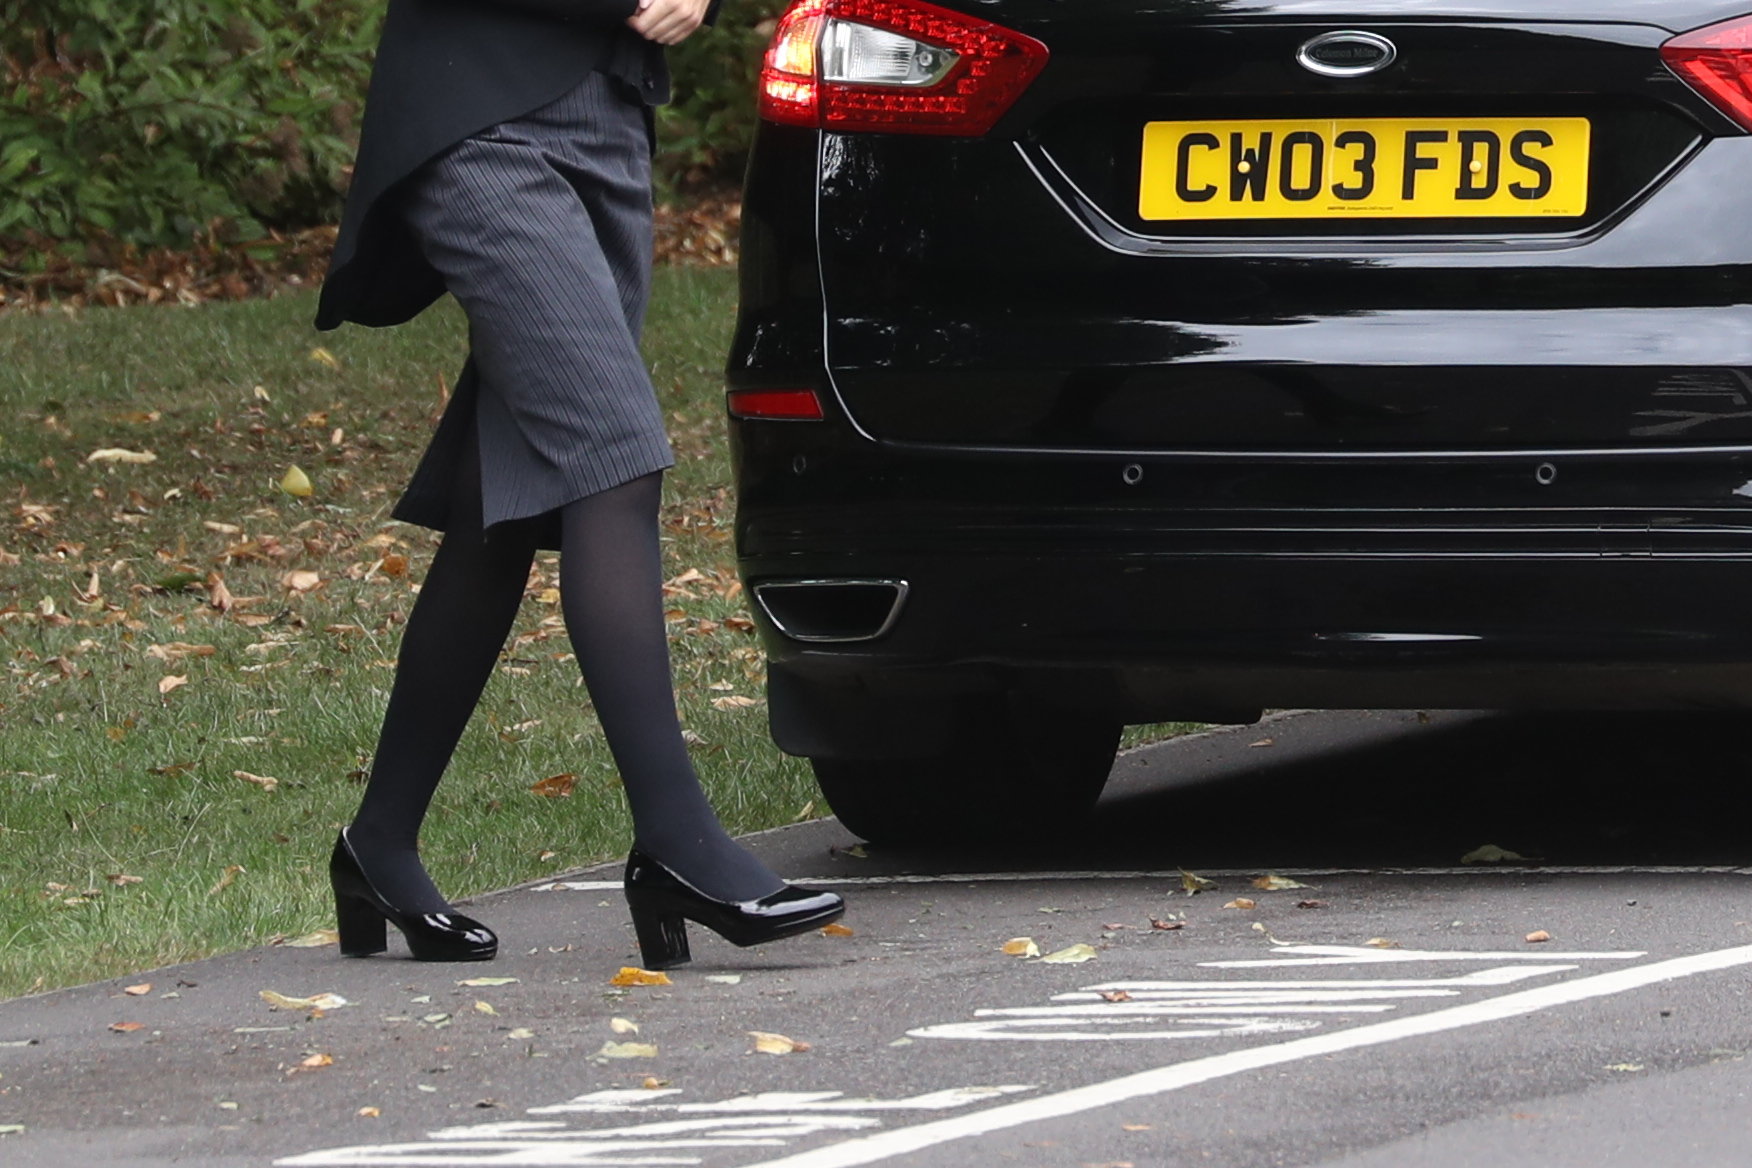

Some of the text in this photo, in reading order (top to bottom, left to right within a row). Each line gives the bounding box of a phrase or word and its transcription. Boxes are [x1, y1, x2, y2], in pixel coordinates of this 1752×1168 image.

[1175, 129, 1554, 202] CW03 FDS
[905, 945, 1649, 1040] ONLY
